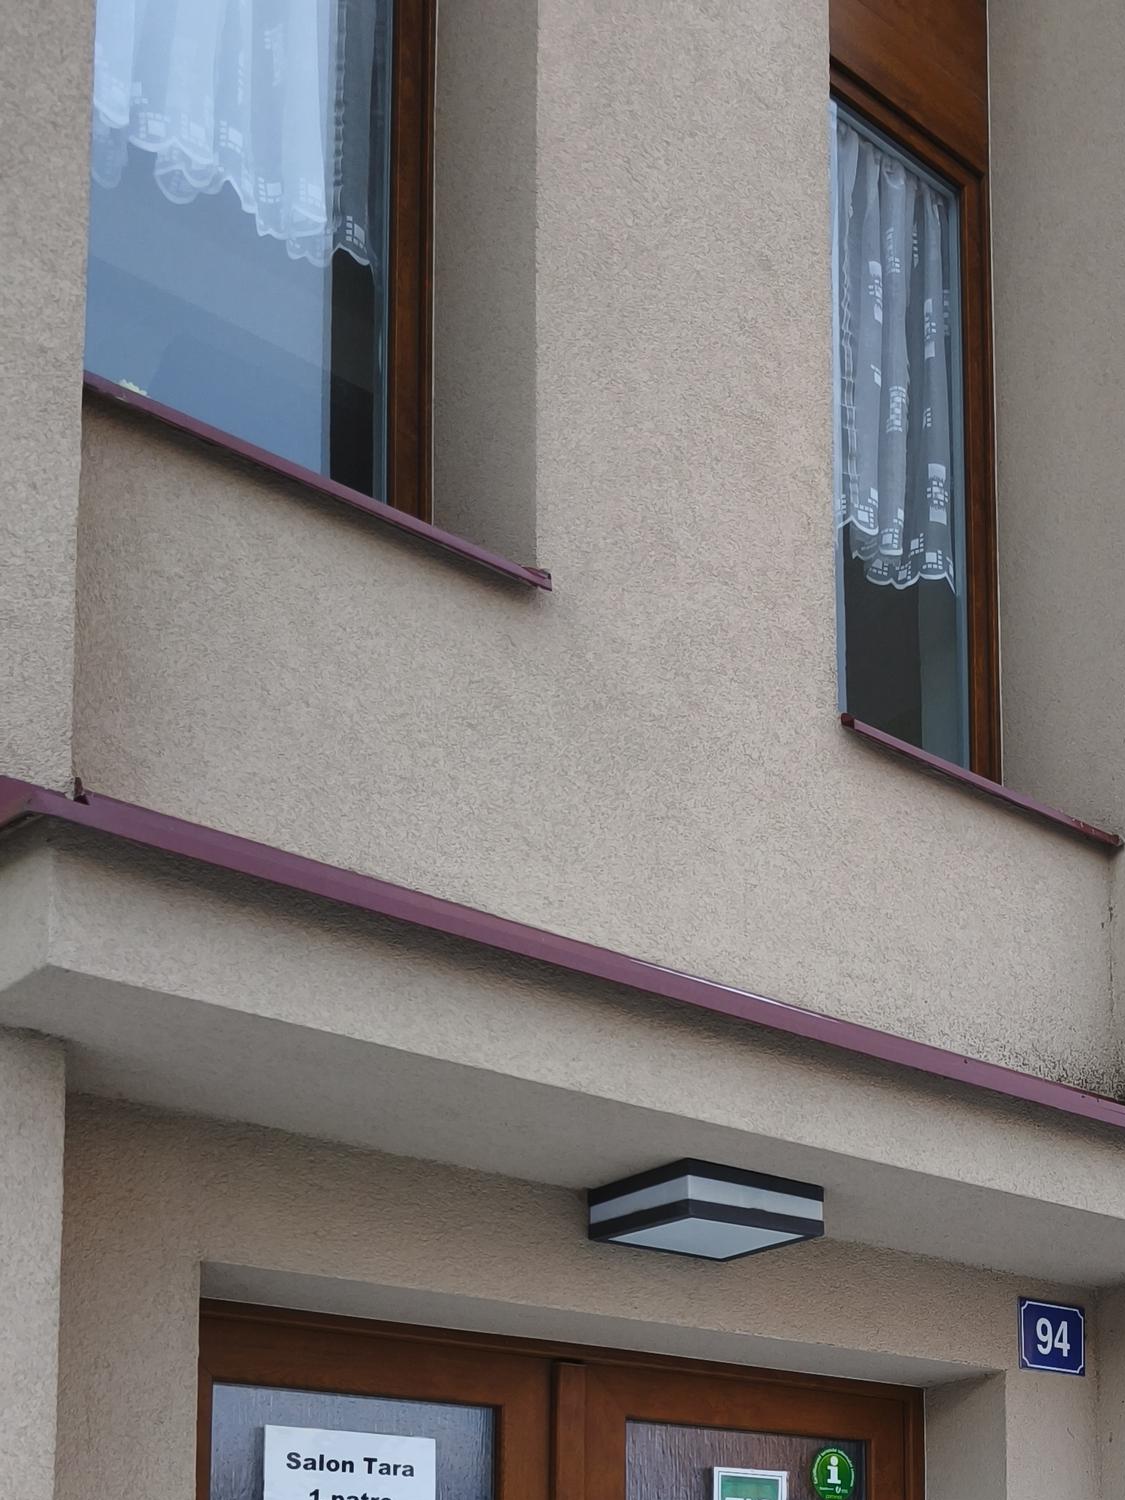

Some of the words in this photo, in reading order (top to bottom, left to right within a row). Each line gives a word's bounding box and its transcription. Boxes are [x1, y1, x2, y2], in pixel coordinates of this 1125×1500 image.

[1036, 1317, 1071, 1357] 94
[286, 1452, 355, 1474] Salon
[363, 1457, 415, 1477] Tara
